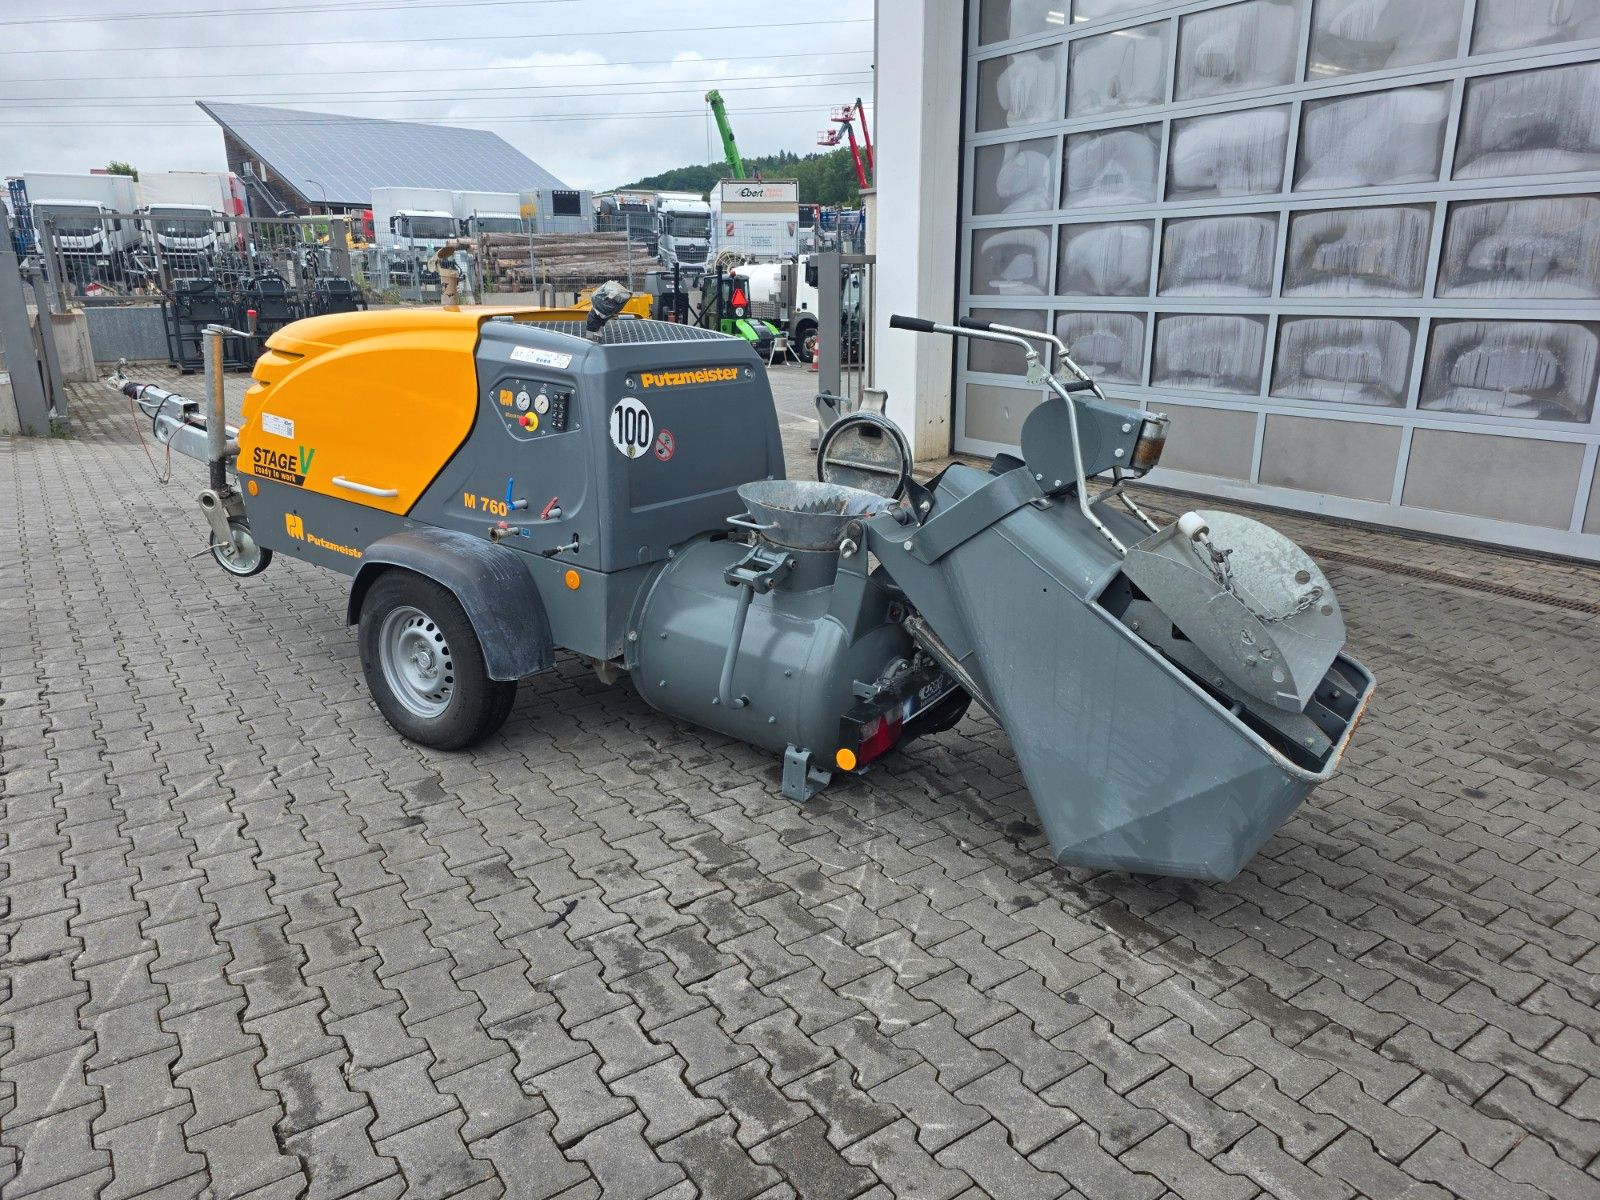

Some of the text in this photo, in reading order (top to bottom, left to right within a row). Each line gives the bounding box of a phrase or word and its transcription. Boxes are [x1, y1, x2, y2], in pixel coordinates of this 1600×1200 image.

[740, 187, 764, 198] Ebert
[641, 367, 738, 389] Putzmeister
[615, 405, 650, 448] 100
[253, 445, 316, 475] STAGE V
[255, 465, 296, 483] ready to work
[463, 492, 508, 517] M 760
[307, 533, 362, 558] Putzmeiste
